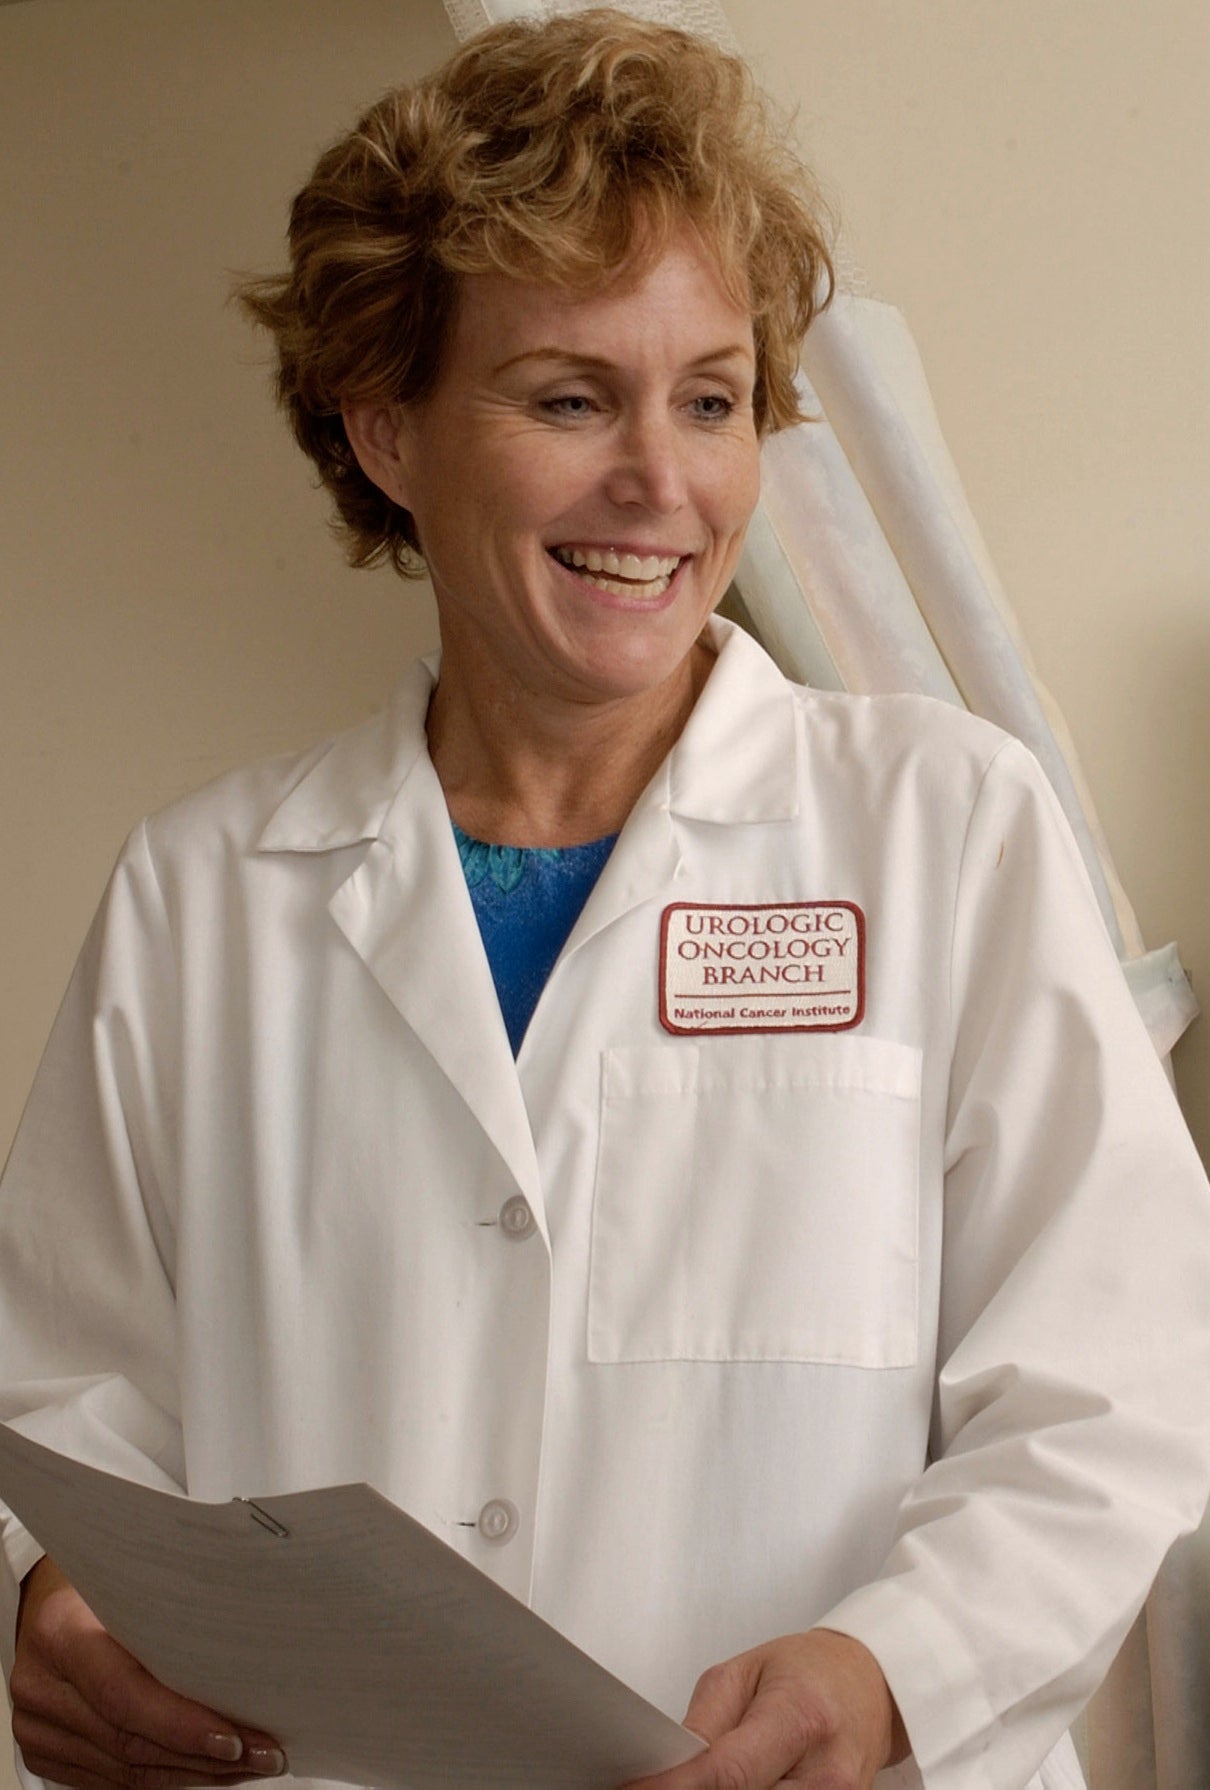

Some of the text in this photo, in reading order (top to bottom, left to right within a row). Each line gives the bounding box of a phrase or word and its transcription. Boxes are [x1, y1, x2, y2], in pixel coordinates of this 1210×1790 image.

[686, 912, 844, 936] UROLOGIC
[678, 938, 851, 960] ONCOLOGY
[702, 964, 826, 985] BRANCH
[674, 1004, 851, 1020] National Cancer Institute
